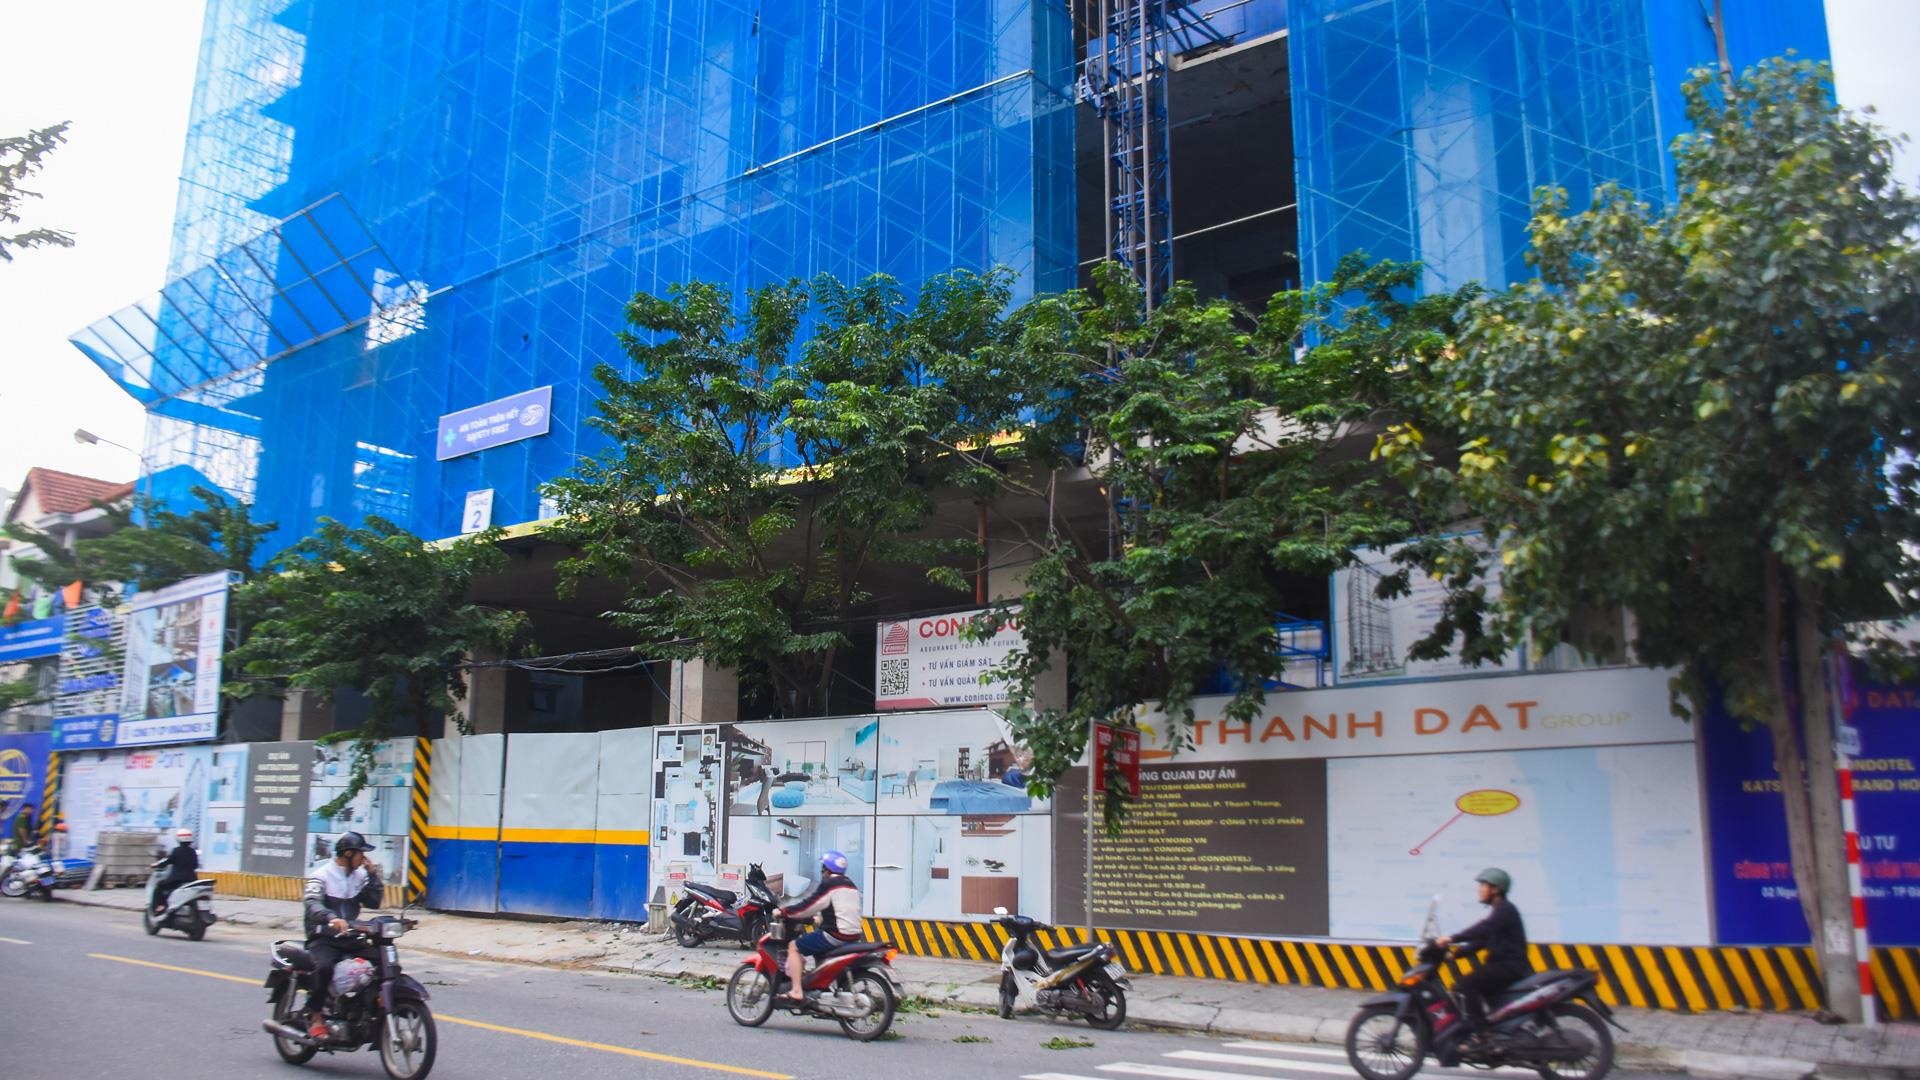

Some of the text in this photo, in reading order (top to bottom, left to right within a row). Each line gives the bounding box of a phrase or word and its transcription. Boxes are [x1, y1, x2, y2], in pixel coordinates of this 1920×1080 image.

[491, 423, 509, 435] FIRST
[472, 510, 482, 529] 2
[920, 644, 957, 653] ASSURANCE
[957, 656, 975, 668] GIÁM
[1194, 701, 1632, 745] THANH DAT GROUP
[1161, 769, 1195, 780] QUAN
[1198, 769, 1216, 781] DỰ
[1218, 766, 1236, 779] ÁN
